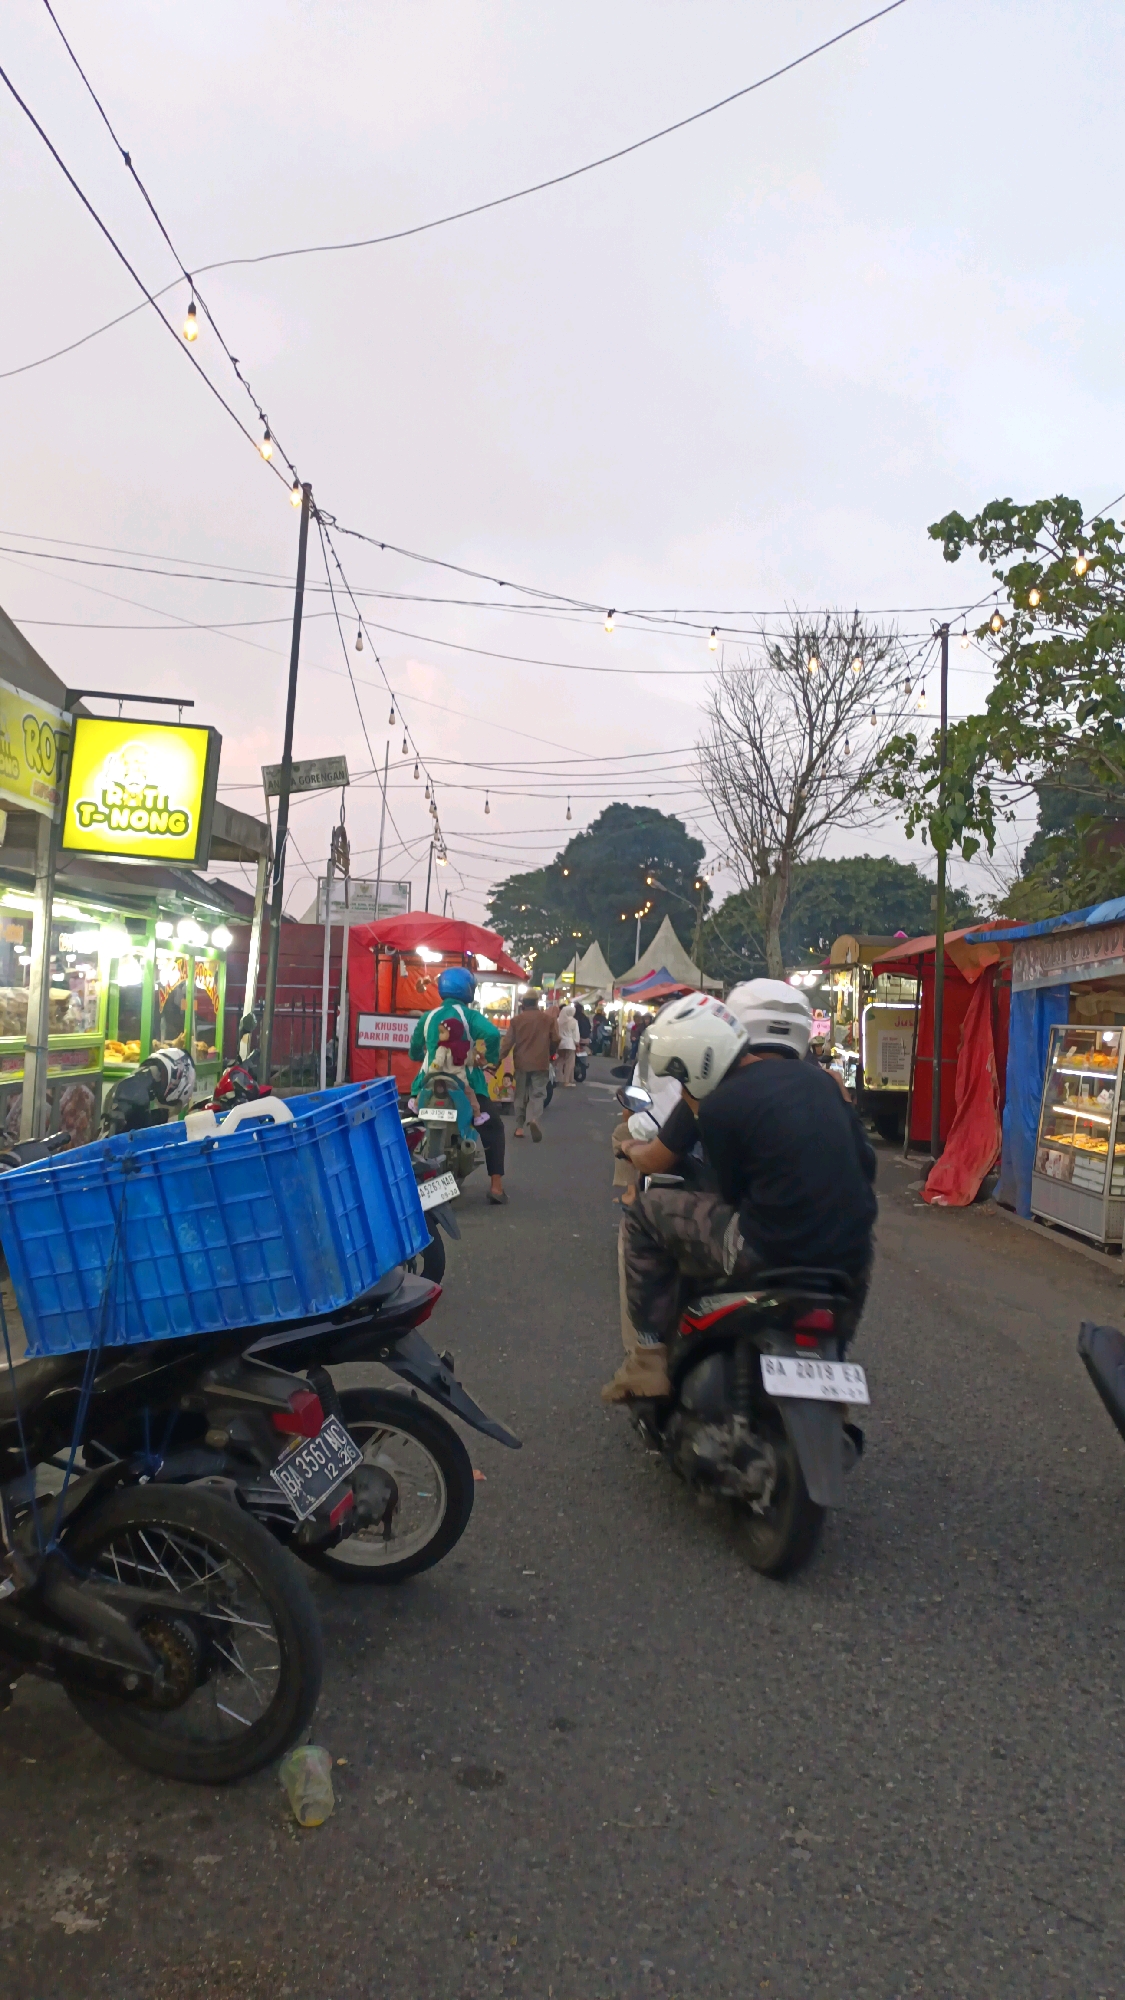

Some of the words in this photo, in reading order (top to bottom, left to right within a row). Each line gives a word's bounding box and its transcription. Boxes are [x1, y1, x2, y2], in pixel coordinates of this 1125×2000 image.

[23, 714, 70, 784] ROT
[298, 770, 345, 786] GORENGAN
[77, 802, 189, 836] T-NONG
[359, 1031, 390, 1041] PARKIR
[392, 1033, 413, 1043] ROD
[375, 1022, 409, 1032] KHUSUS
[280, 1464, 305, 1498] BA
[295, 1437, 332, 1479] 3567
